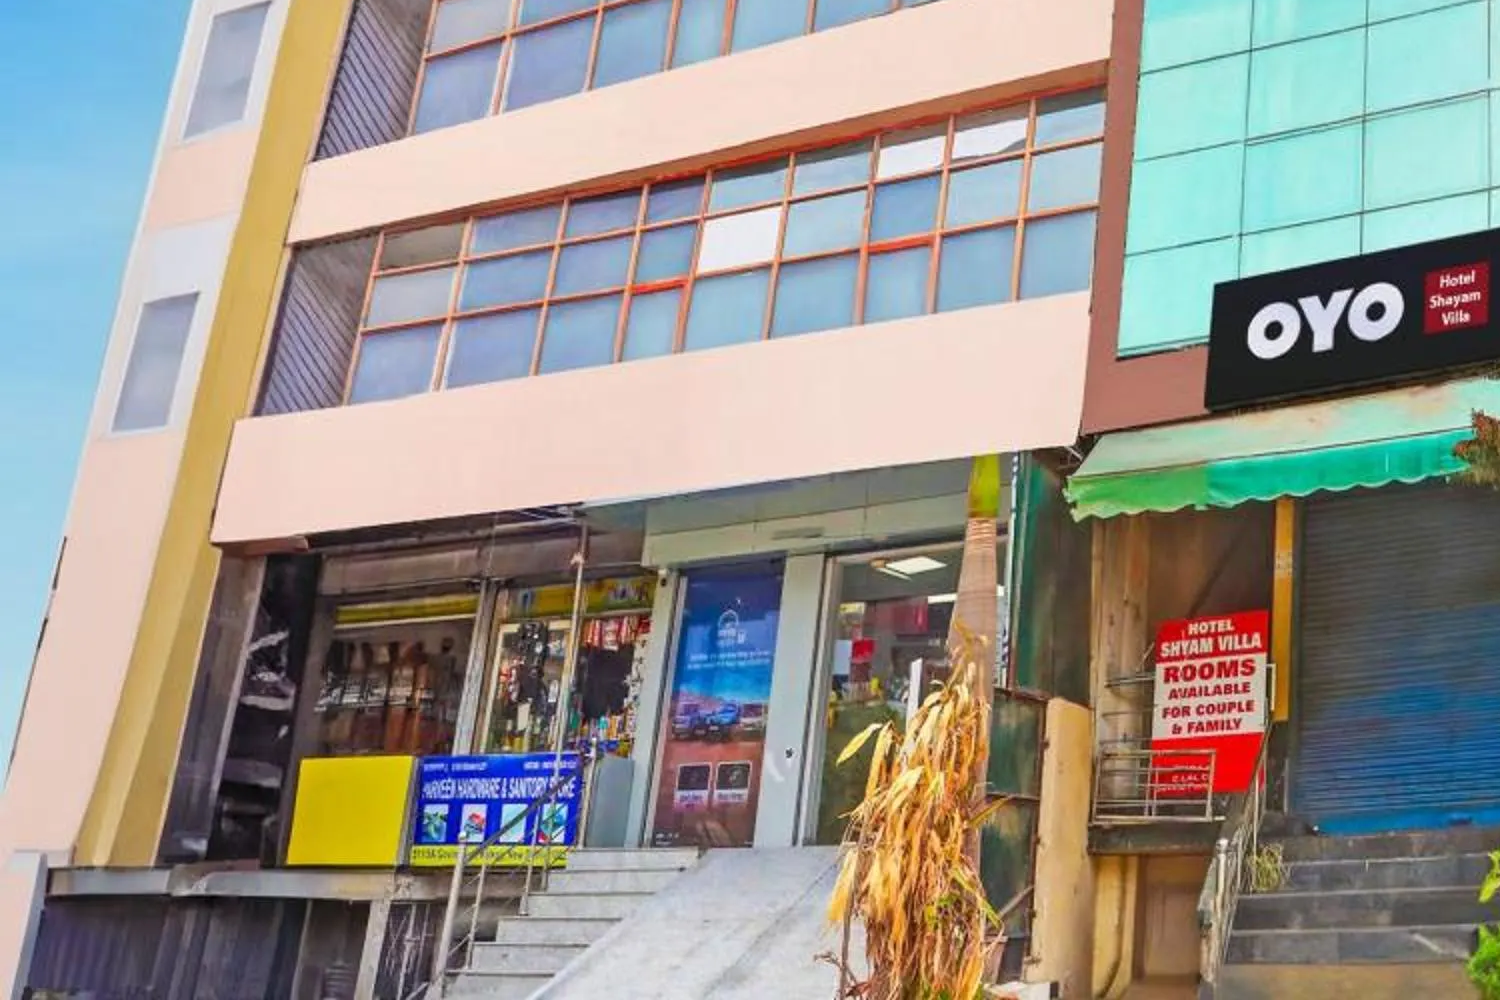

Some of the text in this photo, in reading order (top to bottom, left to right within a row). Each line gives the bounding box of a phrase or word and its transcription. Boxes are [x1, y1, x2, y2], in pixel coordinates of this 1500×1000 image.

[1439, 269, 1476, 288] Hotel
[1429, 290, 1481, 309] Shayam
[1247, 282, 1404, 360] OYO
[1441, 309, 1471, 326] Villa
[1188, 619, 1235, 636] HOTEL
[1160, 632, 1263, 658] SHYAM VILLA
[1163, 659, 1257, 685] ROOMS
[1168, 681, 1251, 701] AVAILABLE
[1162, 699, 1256, 720] FOR COUPLE
[1172, 717, 1243, 735] & FAMILY
